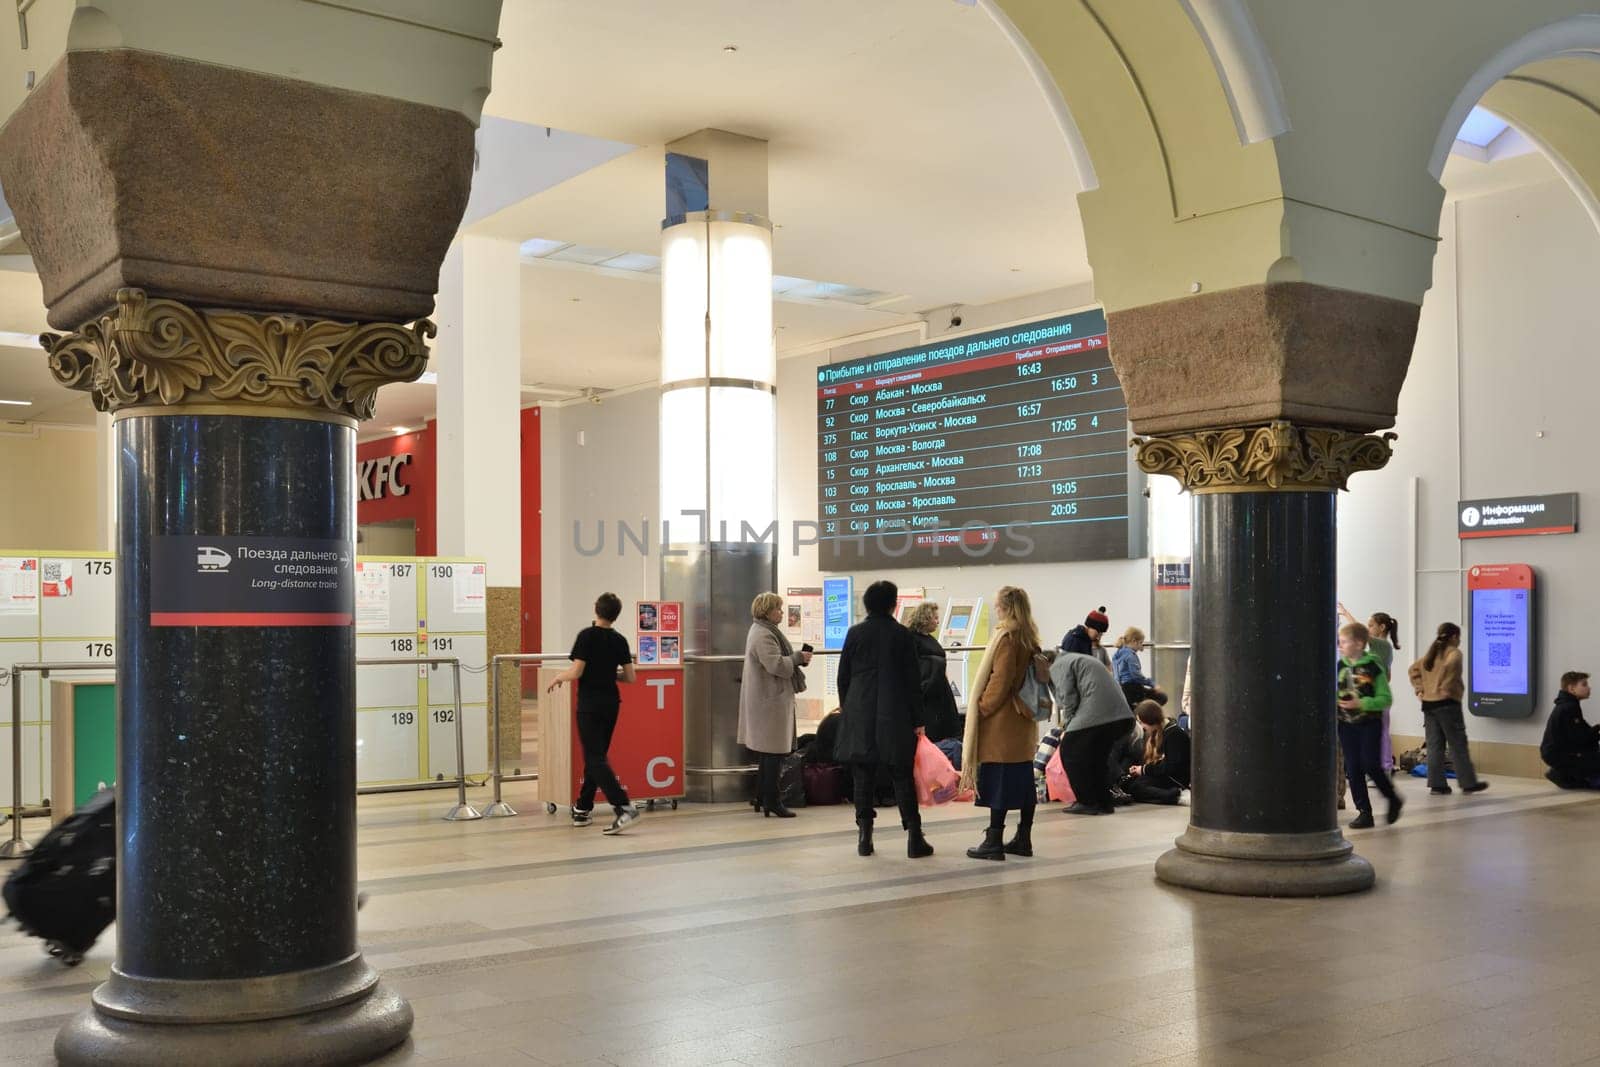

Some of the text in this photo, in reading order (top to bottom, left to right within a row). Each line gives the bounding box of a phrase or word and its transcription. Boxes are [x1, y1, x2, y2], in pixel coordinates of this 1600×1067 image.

[826, 323, 1072, 382] Прибытие и отправление поездов дальнего следования
[1016, 350, 1042, 360] Прибытие
[1045, 342, 1082, 354] Отправление
[1088, 339, 1102, 350] Путь
[826, 399, 835, 410] 77
[850, 395, 869, 406] Скор
[876, 389, 904, 401] Абакан
[911, 381, 942, 395] Москва
[1017, 362, 1042, 377] 16:43
[825, 417, 835, 428] 92
[850, 413, 869, 425] Скор
[876, 408, 905, 420] Москва
[912, 394, 986, 414] Северобайкальск
[1051, 377, 1077, 391] 16:50
[1091, 374, 1098, 385] 3
[824, 434, 837, 445] 375
[851, 431, 868, 442] Пасс
[876, 421, 937, 439] Воркута-Усинск
[944, 414, 977, 428] Москва
[1017, 403, 1042, 417] 16:57
[824, 452, 837, 463] 108
[850, 449, 869, 460] Скор
[876, 445, 905, 457] Москва
[912, 438, 945, 451] Вологда
[1051, 419, 1077, 433] 17:05
[1091, 416, 1098, 427] 4
[826, 469, 835, 480] 15
[850, 467, 869, 478] Скор
[876, 461, 925, 475] Архангельск
[932, 456, 964, 468] Москва
[1017, 444, 1042, 457] 17:08
[358, 453, 411, 501] KFC
[824, 487, 837, 497] 103
[850, 485, 869, 496] Скор
[876, 479, 917, 493] Ярославль
[924, 476, 956, 488] Москва
[1017, 465, 1042, 478] 17:13
[824, 504, 837, 515] 106
[850, 503, 869, 514] Скор
[876, 500, 906, 511] Москва
[912, 495, 956, 510] Ярославль
[1051, 481, 1077, 495] 19:05
[1482, 503, 1545, 516] Информация
[826, 522, 835, 533] 32
[850, 520, 869, 532] Скор
[876, 518, 906, 529] Москва
[912, 515, 939, 528] Киров
[1051, 503, 1077, 516] 20:05
[238, 547, 338, 562] Поезда дальнего
[85, 561, 112, 575] 175
[274, 564, 338, 576] следования
[390, 564, 412, 577] 187
[432, 565, 453, 578] 190
[251, 579, 338, 591] Long-distance trains
[86, 643, 113, 657] 176
[391, 639, 413, 652] 188
[433, 638, 453, 651] 191
[392, 712, 414, 725] 189
[433, 710, 454, 723] 192
